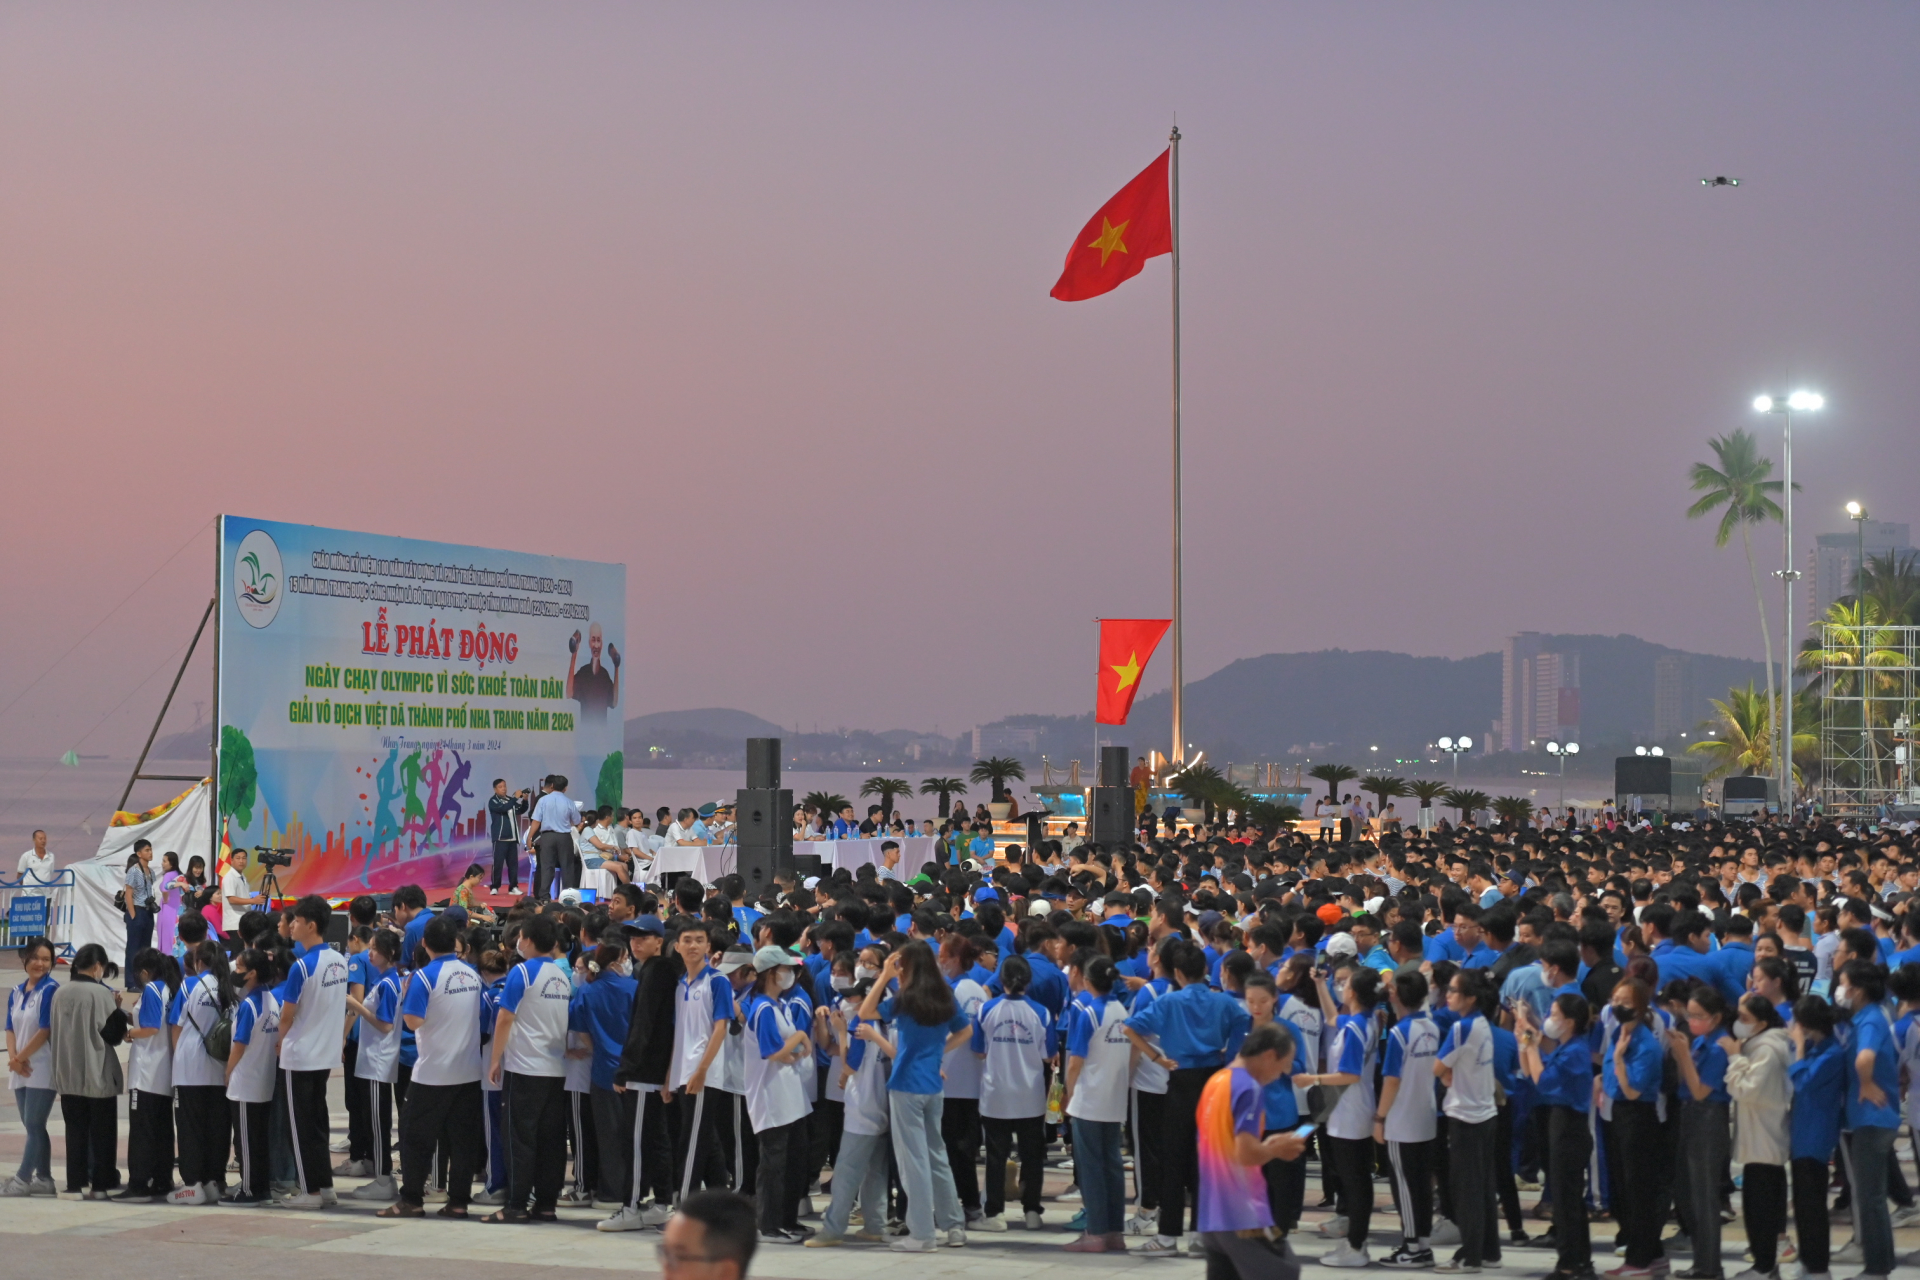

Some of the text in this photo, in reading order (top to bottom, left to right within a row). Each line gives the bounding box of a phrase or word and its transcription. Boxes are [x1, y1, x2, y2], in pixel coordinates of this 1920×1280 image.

[312, 549, 330, 570] CHÀO
[330, 551, 350, 572] MỪNG
[360, 555, 377, 577] NIỆM
[377, 559, 389, 576] 100
[389, 558, 404, 578] NĂM
[404, 559, 417, 579] XÂY
[417, 563, 435, 583] DỰNG
[435, 563, 443, 582] VÀ
[444, 564, 459, 583] PHÁT
[459, 564, 476, 586] TRIỂN
[477, 567, 496, 587] THÀNH
[496, 568, 508, 588] PHỐ
[508, 573, 520, 590] NHA
[520, 574, 538, 592] TRANG
[289, 575, 298, 593] 15
[299, 574, 314, 594] NĂM
[314, 578, 329, 596] NHA
[329, 579, 351, 598] TRANG
[369, 581, 386, 601] CÔNG
[386, 584, 404, 606] NHẬN
[452, 591, 467, 612] TRỰC
[468, 592, 486, 614] THUỘC
[486, 592, 500, 612] TỈNH
[500, 595, 519, 613] KHÁNH
[362, 606, 519, 670] LỄ PHÁT ĐỘNG
[305, 662, 564, 699] NGÀY CHẠY OLYMPIC VÌ SỨC KHOẺ TOÀN DÂN
[289, 694, 574, 732] GIẢI VÔ ĐỊCH VIỆT DÃ THÀNH PHỐ NHA TRANG NĂM 2024
[467, 739, 472, 750] 3
[487, 739, 501, 750] 2024
[175, 1190, 195, 1200] BOSTON
